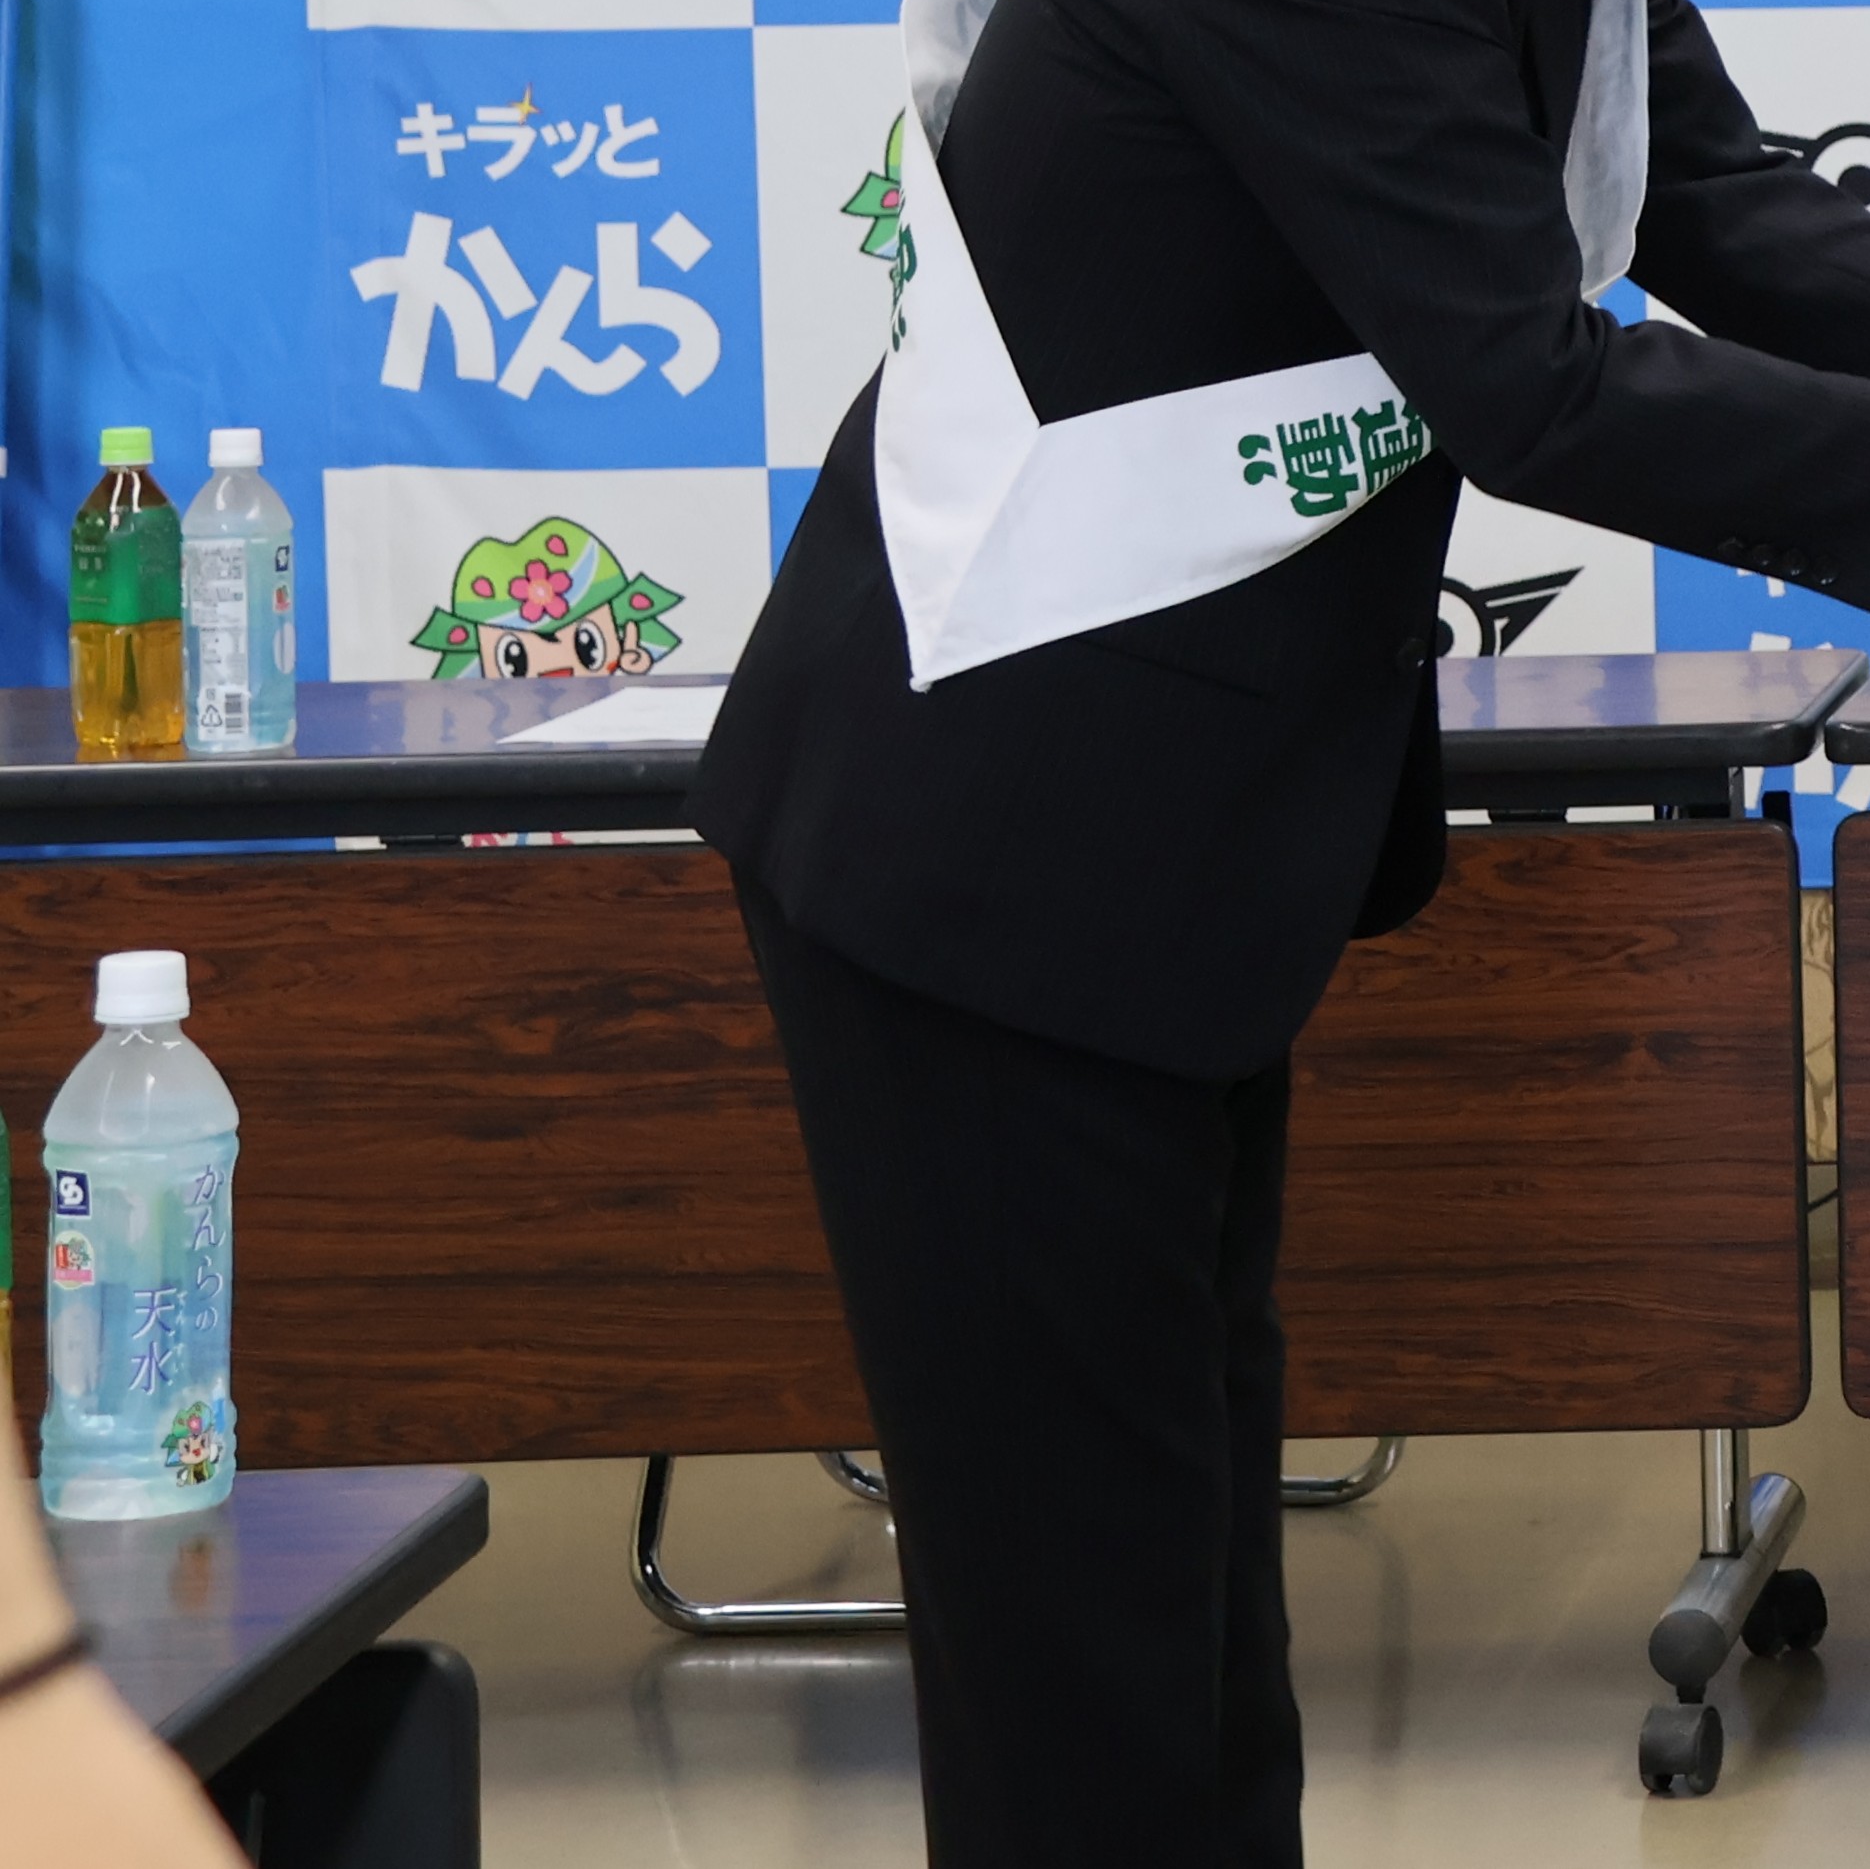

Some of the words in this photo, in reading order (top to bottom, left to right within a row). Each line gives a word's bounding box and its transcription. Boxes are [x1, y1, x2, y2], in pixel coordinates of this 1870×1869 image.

[396, 99, 660, 179] キラッと
[351, 212, 721, 399] かんら
[191, 1164, 226, 1332] かんらの
[129, 1287, 177, 1396] 天水
